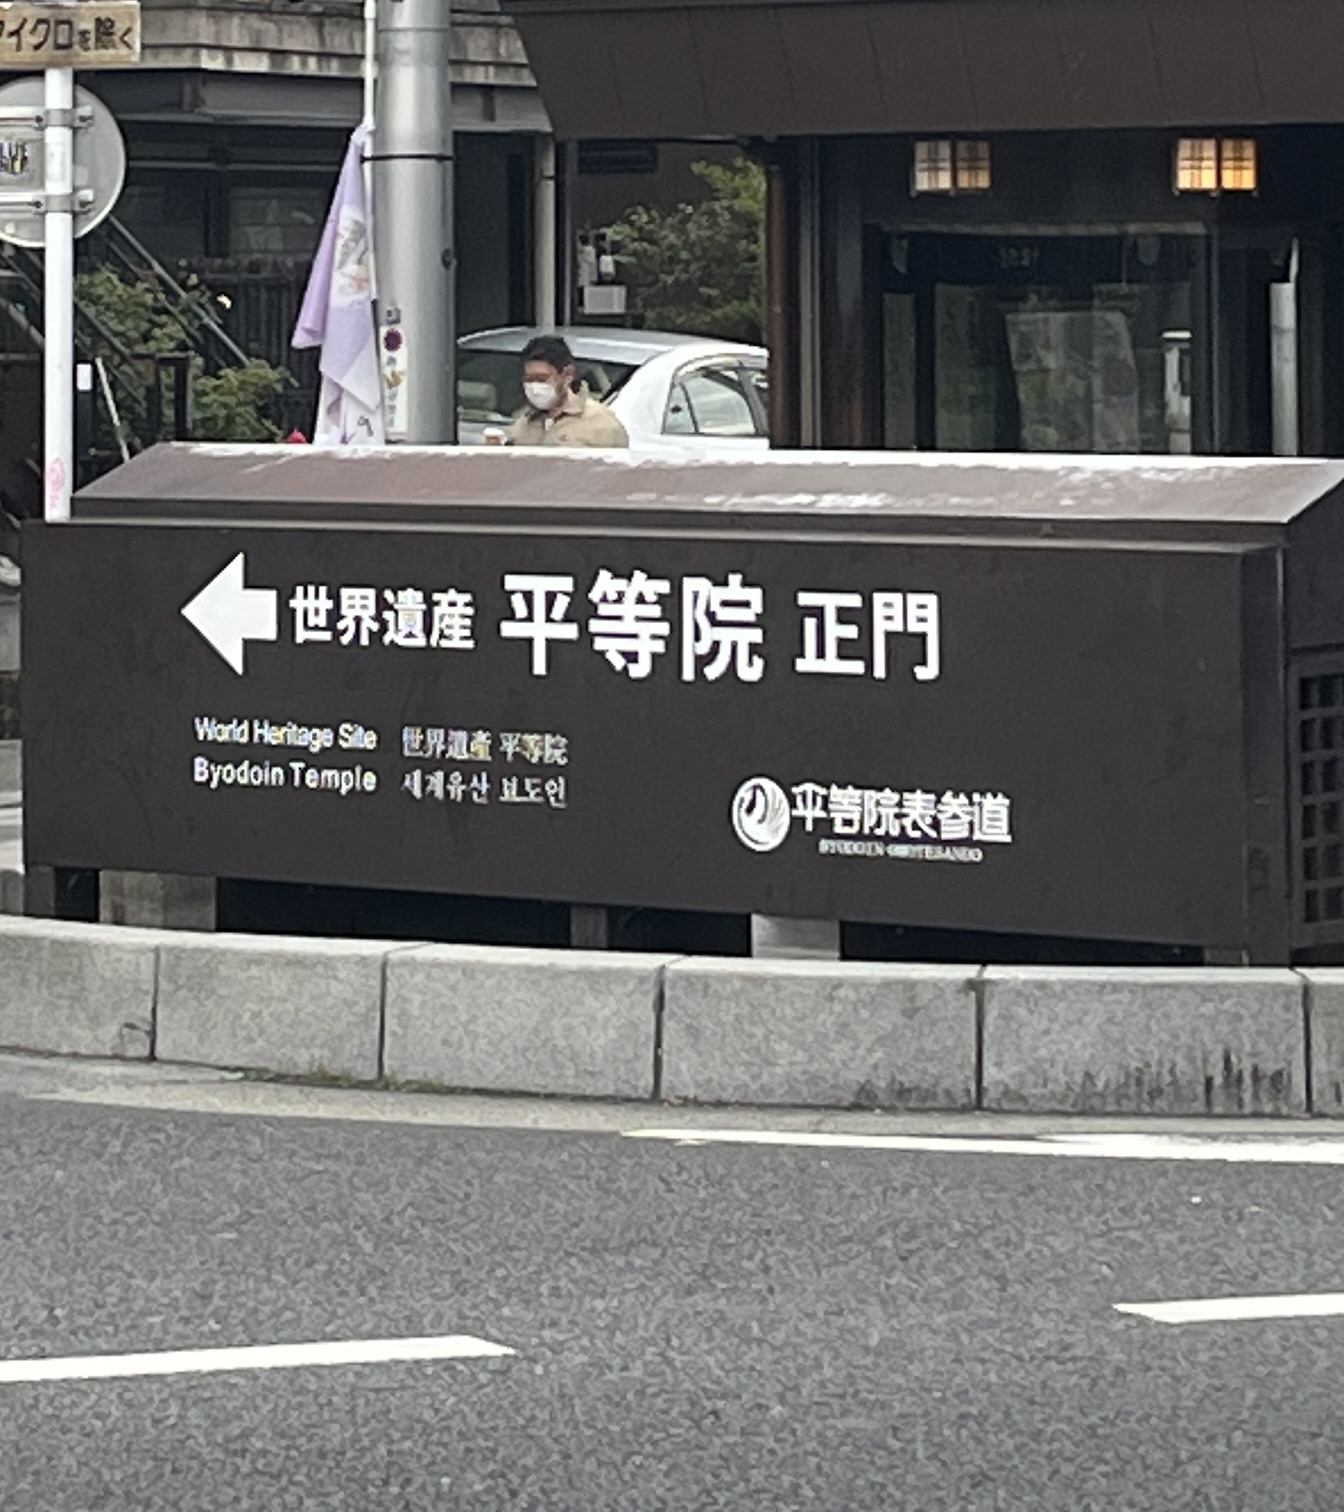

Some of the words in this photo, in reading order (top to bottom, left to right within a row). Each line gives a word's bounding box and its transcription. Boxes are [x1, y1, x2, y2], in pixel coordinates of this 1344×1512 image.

[288, 584, 475, 650] 世界遺産
[499, 568, 765, 682] 平等院
[795, 591, 940, 681] 正門
[194, 717, 250, 744] World
[253, 719, 334, 754] Heritage
[338, 722, 378, 750] Site
[193, 756, 285, 789] Byodoin
[288, 761, 377, 796] Temple
[402, 768, 490, 804] 세계유산
[790, 782, 1013, 843] 平等院表参道
